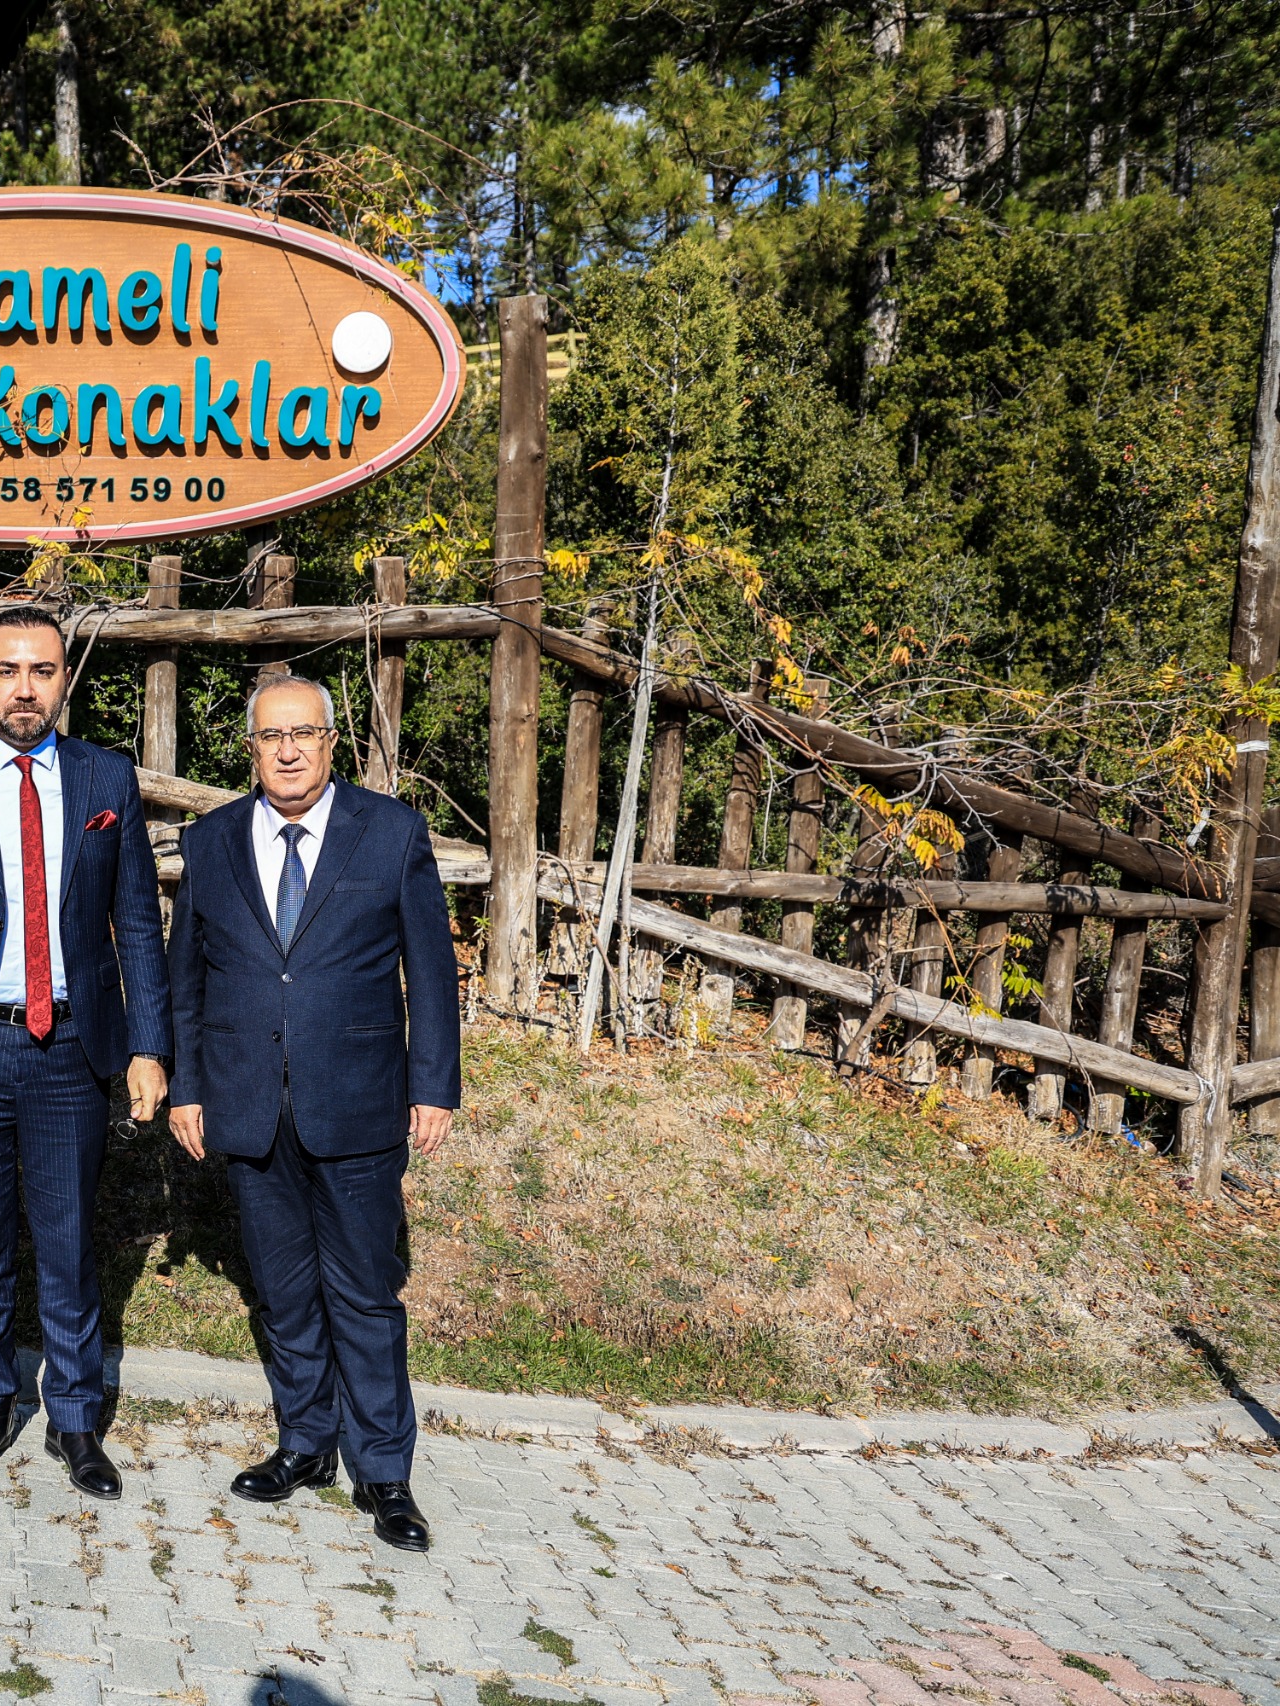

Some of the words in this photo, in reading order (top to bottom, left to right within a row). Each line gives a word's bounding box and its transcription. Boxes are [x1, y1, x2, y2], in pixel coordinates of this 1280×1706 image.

[55, 477, 116, 502] 571
[129, 477, 173, 502] 59
[184, 477, 226, 502] 00
